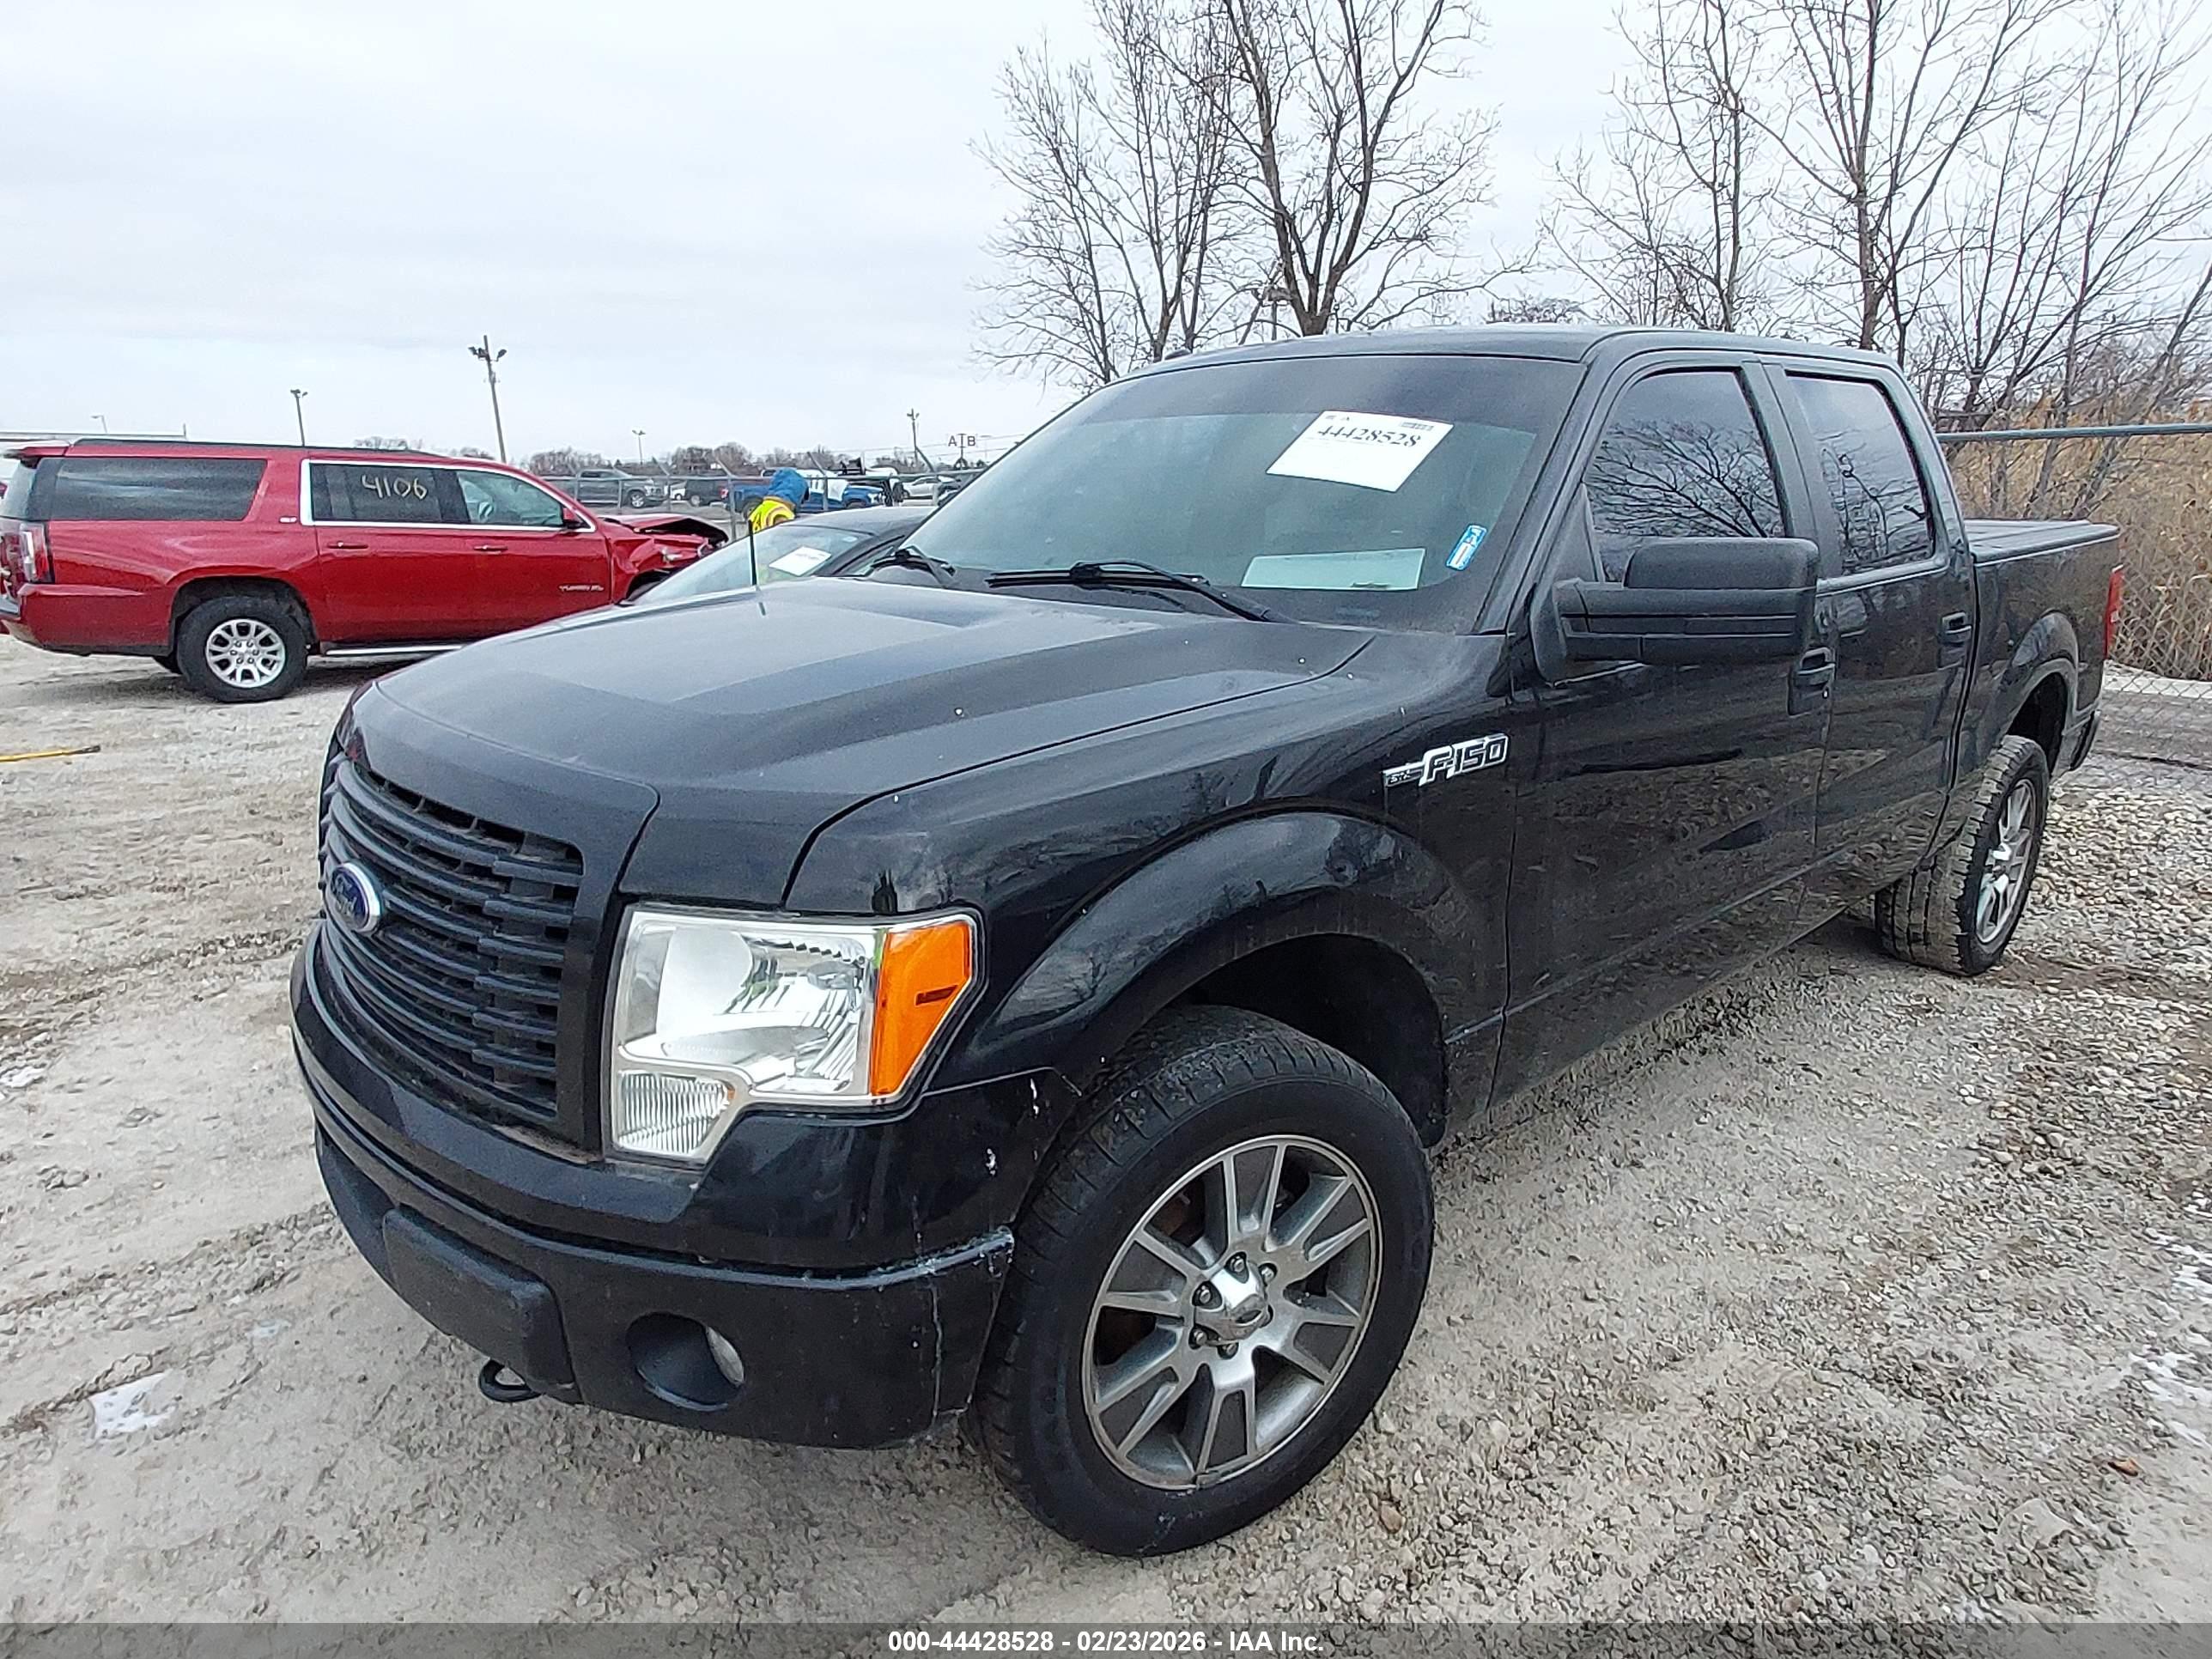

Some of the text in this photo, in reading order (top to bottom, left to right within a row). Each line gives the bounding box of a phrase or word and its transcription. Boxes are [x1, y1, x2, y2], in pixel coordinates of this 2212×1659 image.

[947, 434, 976, 447] A B
[1317, 425, 1421, 447] 44428528
[362, 475, 427, 499] 4106
